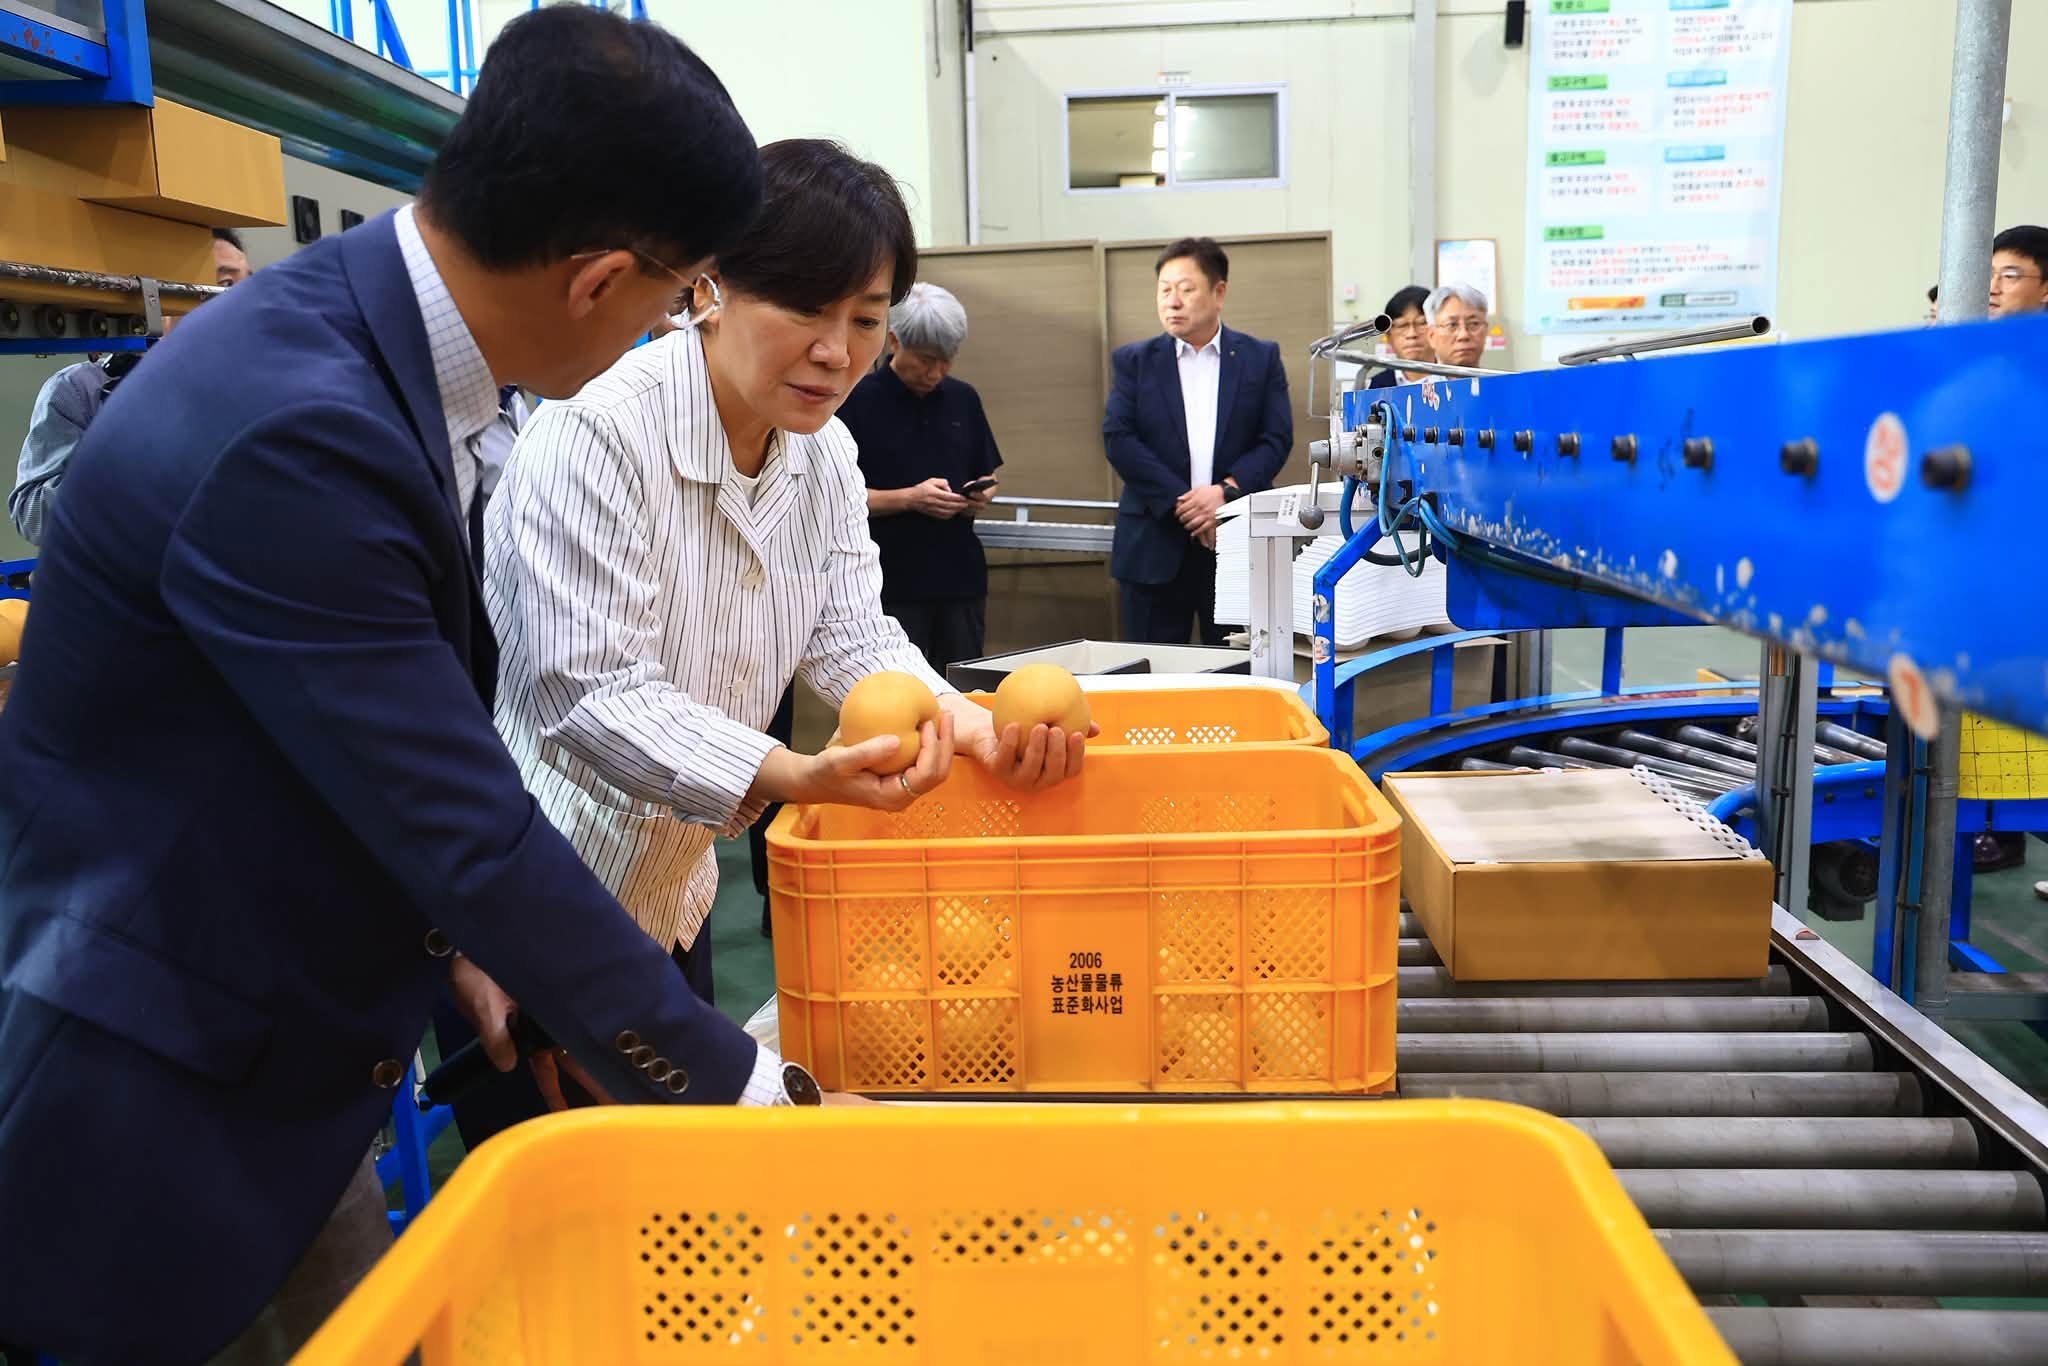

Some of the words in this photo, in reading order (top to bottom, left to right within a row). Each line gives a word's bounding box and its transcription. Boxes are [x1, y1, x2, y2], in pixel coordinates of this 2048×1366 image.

[1069, 952, 1103, 969] 2006
[1051, 973, 1123, 993] 농산물물류
[1051, 995, 1123, 1015] 표준화사업
